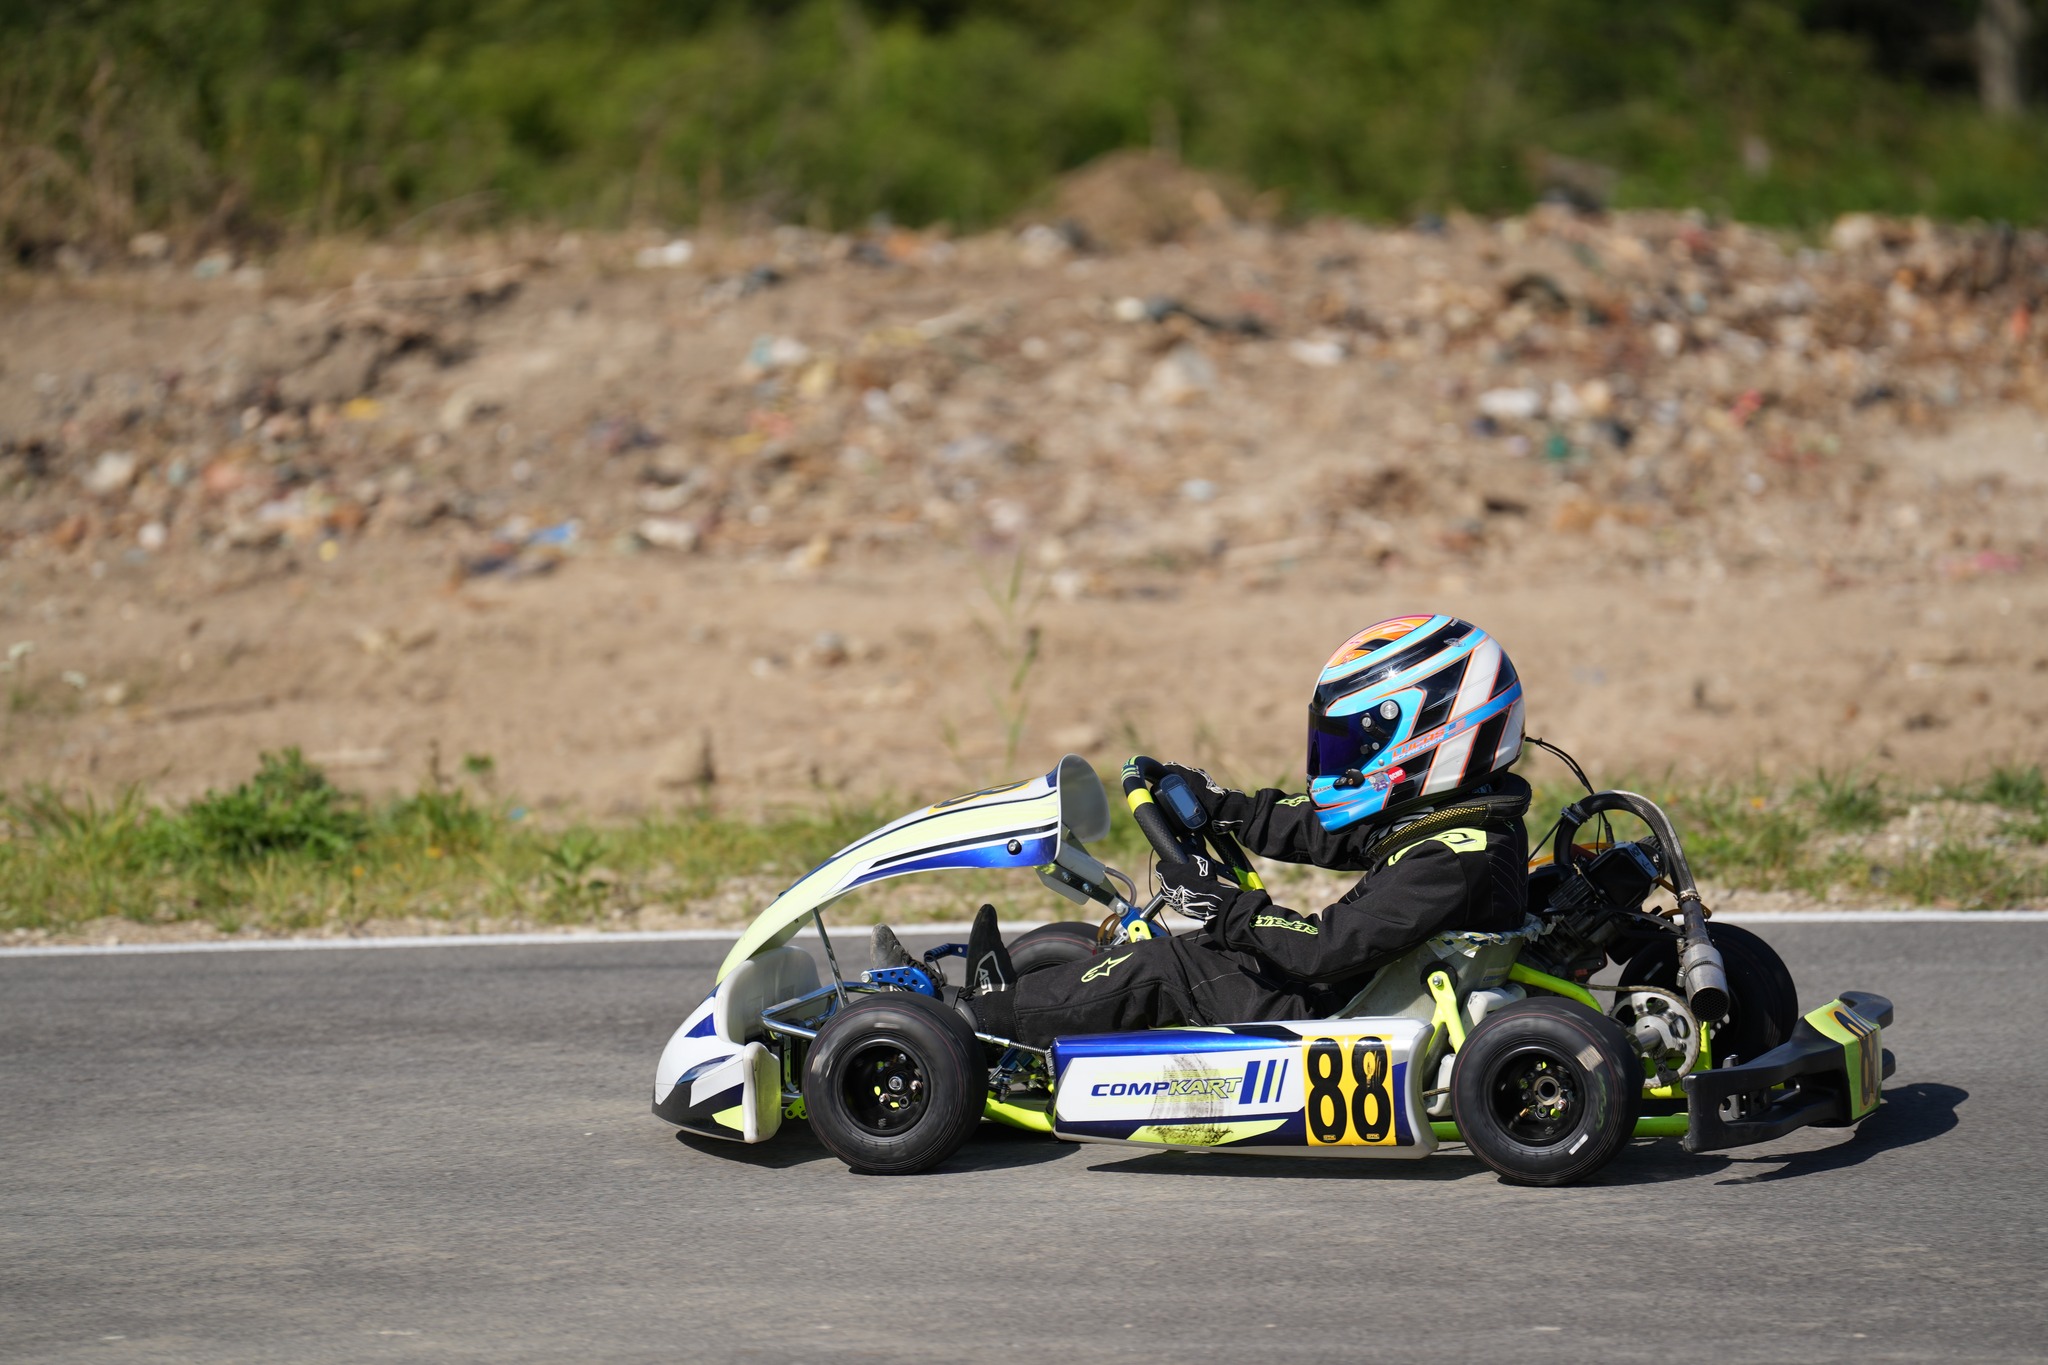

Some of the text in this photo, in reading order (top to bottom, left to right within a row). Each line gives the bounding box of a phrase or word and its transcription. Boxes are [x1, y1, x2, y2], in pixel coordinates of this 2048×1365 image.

[1392, 727, 1446, 758] LUCAS
[1090, 1076, 1243, 1099] COMPKART
[1307, 1036, 1392, 1144] 88
